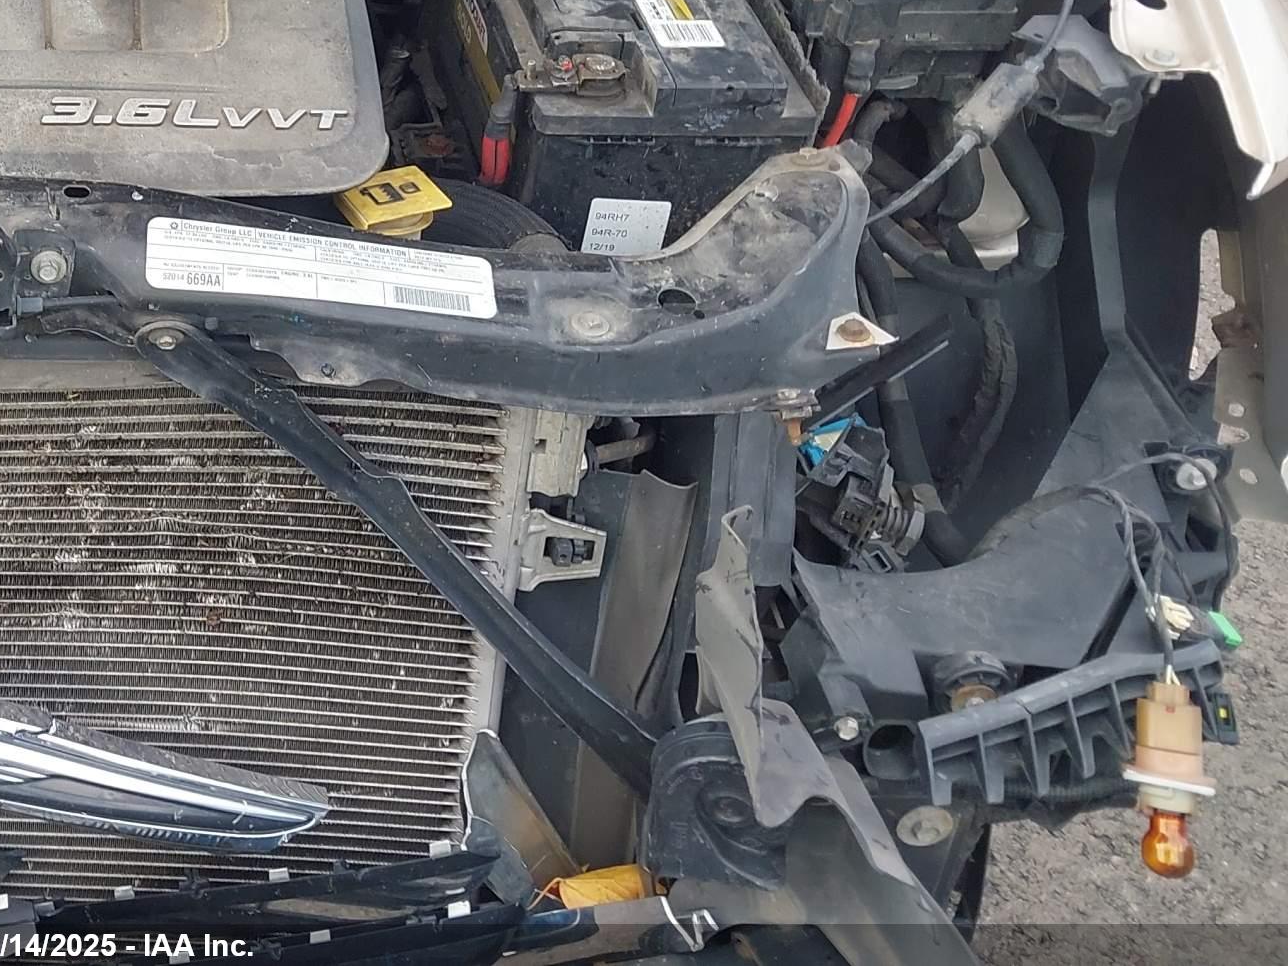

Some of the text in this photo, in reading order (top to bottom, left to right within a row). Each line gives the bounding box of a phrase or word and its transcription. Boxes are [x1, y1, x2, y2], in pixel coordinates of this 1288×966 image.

[595, 211, 630, 222] 94RH7
[591, 227, 628, 238] 94R-70
[184, 222, 212, 233] Chrysler
[215, 225, 237, 235] Group
[239, 228, 252, 236] LLC
[258, 231, 287, 241] VEHICLE
[289, 235, 322, 246] EMISSION
[324, 240, 356, 250] CONTROL
[358, 244, 407, 257] INFORMATION
[589, 242, 615, 252] 12/19
[187, 272, 221, 287] 669AA
